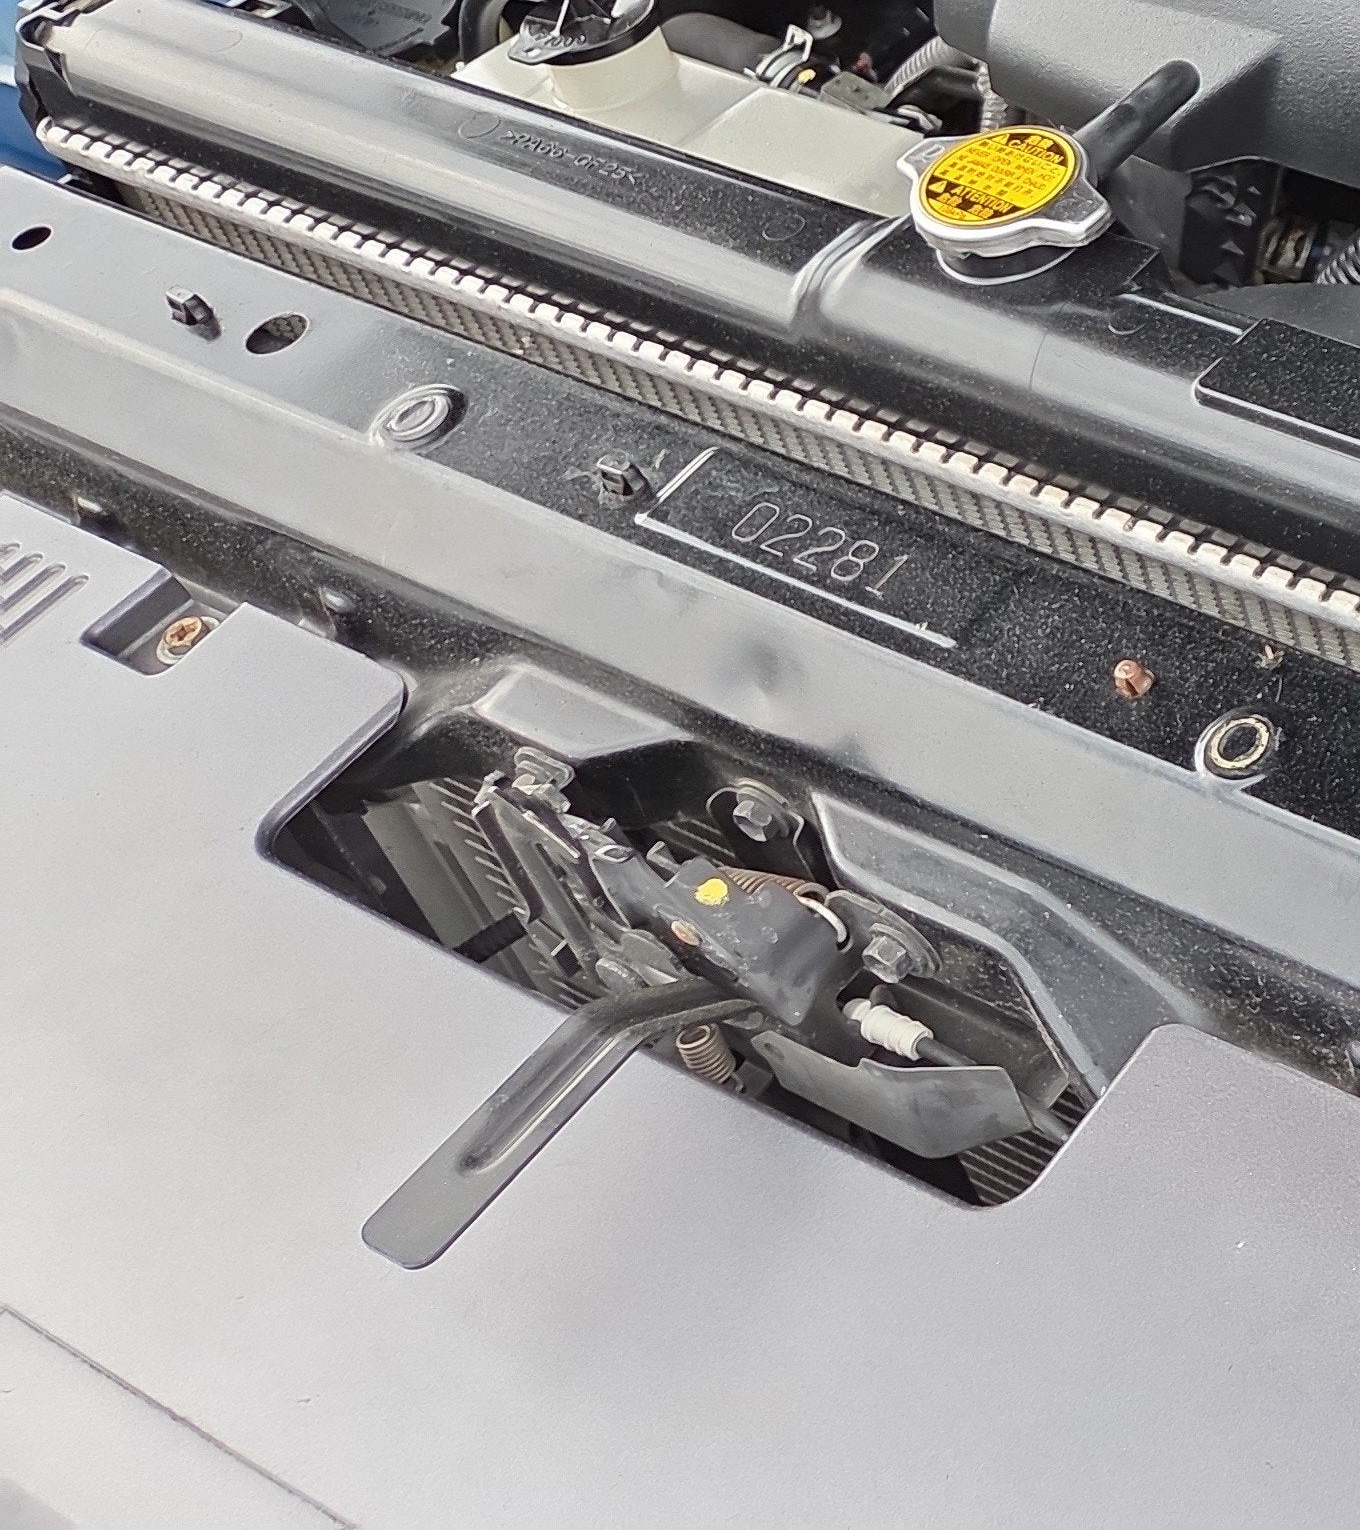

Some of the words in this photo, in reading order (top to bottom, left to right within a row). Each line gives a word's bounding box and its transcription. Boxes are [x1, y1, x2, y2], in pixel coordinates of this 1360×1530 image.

[1009, 139, 1065, 164] CAUTION
[951, 185, 1014, 213] ATTENTION
[731, 501, 910, 601] 02281
